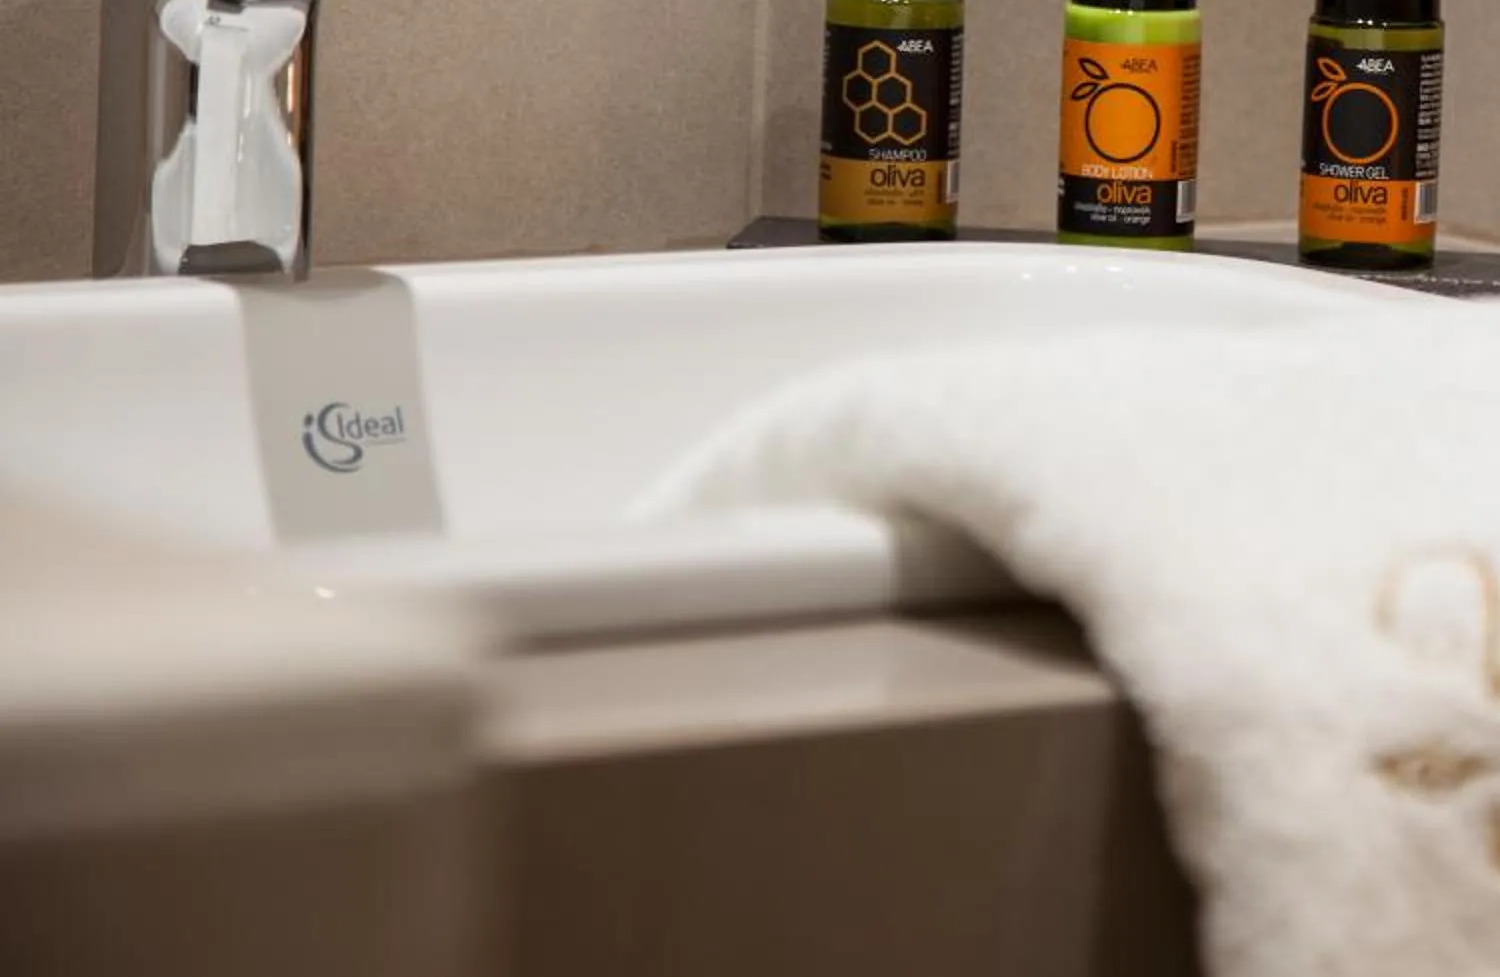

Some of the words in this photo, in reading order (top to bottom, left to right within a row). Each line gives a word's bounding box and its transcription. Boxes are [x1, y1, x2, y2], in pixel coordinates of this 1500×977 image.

[867, 148, 928, 161] SHAMPOO
[870, 164, 925, 188] oliva
[1081, 164, 1110, 177] BODY
[1111, 166, 1153, 180] LOTION
[1319, 162, 1364, 178] SHOWER
[1365, 166, 1389, 180] GEL
[1097, 181, 1152, 204] oliva
[1334, 180, 1387, 205] oliva
[336, 407, 404, 439] Ideal
